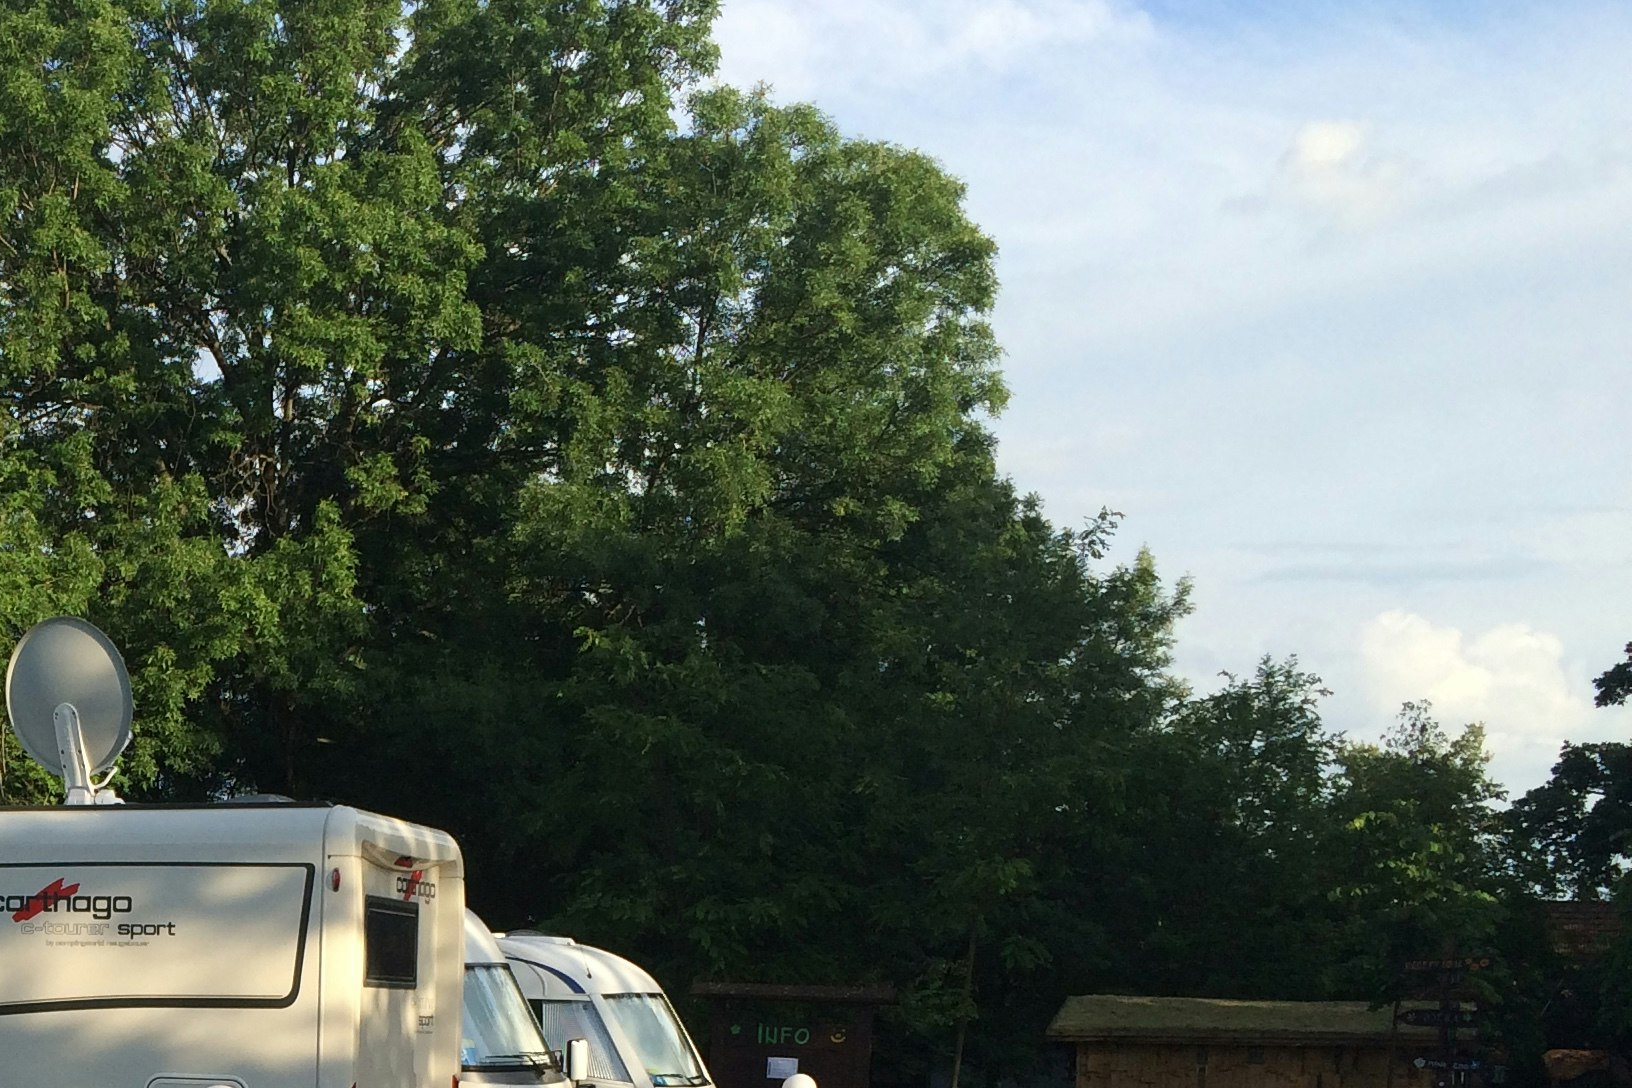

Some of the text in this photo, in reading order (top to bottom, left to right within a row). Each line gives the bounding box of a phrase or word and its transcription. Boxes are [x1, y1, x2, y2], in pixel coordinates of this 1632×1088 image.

[20, 921, 176, 940] c-tourer sport
[757, 1022, 810, 1045] INFO
